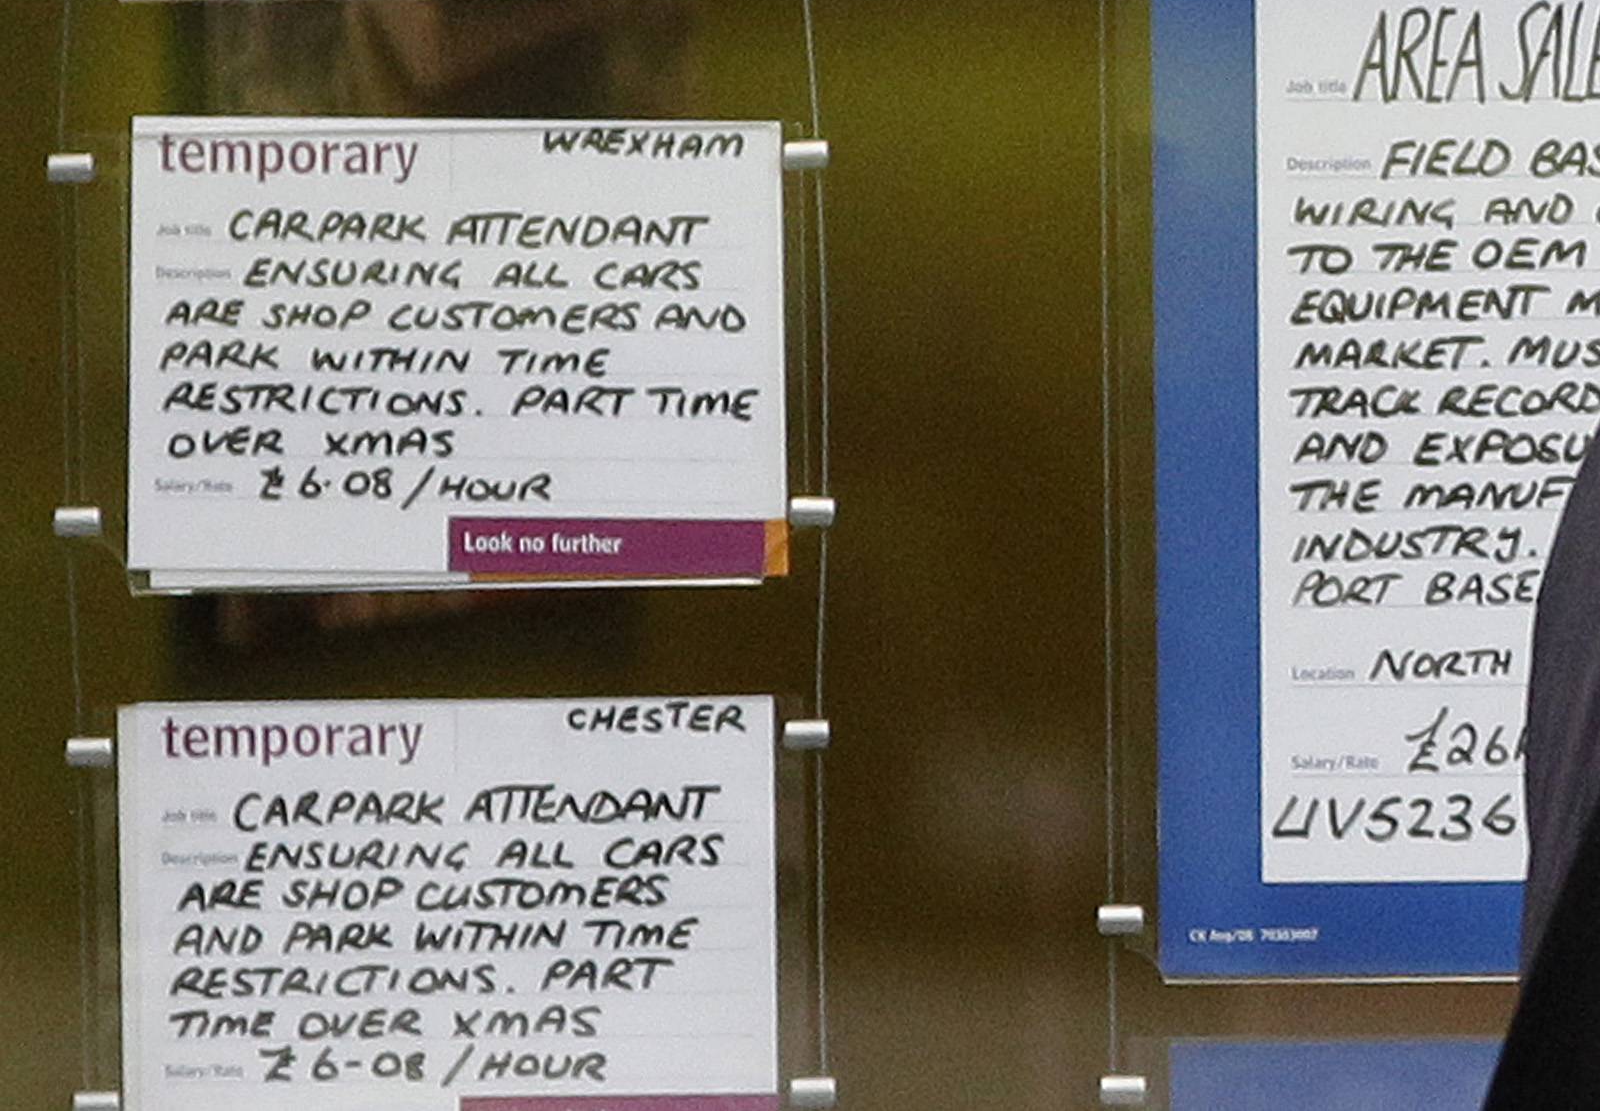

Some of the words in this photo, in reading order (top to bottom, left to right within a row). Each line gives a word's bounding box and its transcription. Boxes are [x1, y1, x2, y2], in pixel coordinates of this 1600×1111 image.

[1353, 7, 1485, 104] AREA
[1286, 80, 1313, 93] Job
[1319, 80, 1346, 94] title
[158, 131, 418, 183] temporary
[543, 127, 743, 158] WREXHAM
[1381, 139, 1511, 180] FIELD
[1287, 157, 1371, 172] Description
[1295, 197, 1455, 230] WIRING
[1485, 193, 1573, 225] AND
[446, 212, 710, 249] ATTENDANT
[1287, 244, 1353, 275] TO
[1372, 239, 1458, 272] THE
[1472, 238, 1586, 270] OEM
[1290, 284, 1550, 325] EQUIPMENT
[160, 340, 278, 371] PARK
[312, 348, 469, 373] WITHIN
[1294, 336, 1489, 370] MARKET.
[1290, 385, 1420, 418] TRACK
[169, 426, 283, 459] OVER
[326, 427, 454, 458] XMAS
[1294, 431, 1388, 465] AND
[1290, 479, 1381, 513] THE
[465, 532, 512, 551] Look
[520, 538, 544, 552] no
[553, 533, 621, 553] further
[1294, 570, 1402, 607] PORT
[1292, 667, 1355, 680] Location
[1370, 649, 1512, 680] NORTH
[568, 701, 745, 733] CHESTER
[162, 717, 422, 766] temporary
[1292, 755, 1378, 771] Salary/Rate
[465, 784, 721, 824] ATTENDANT
[245, 839, 469, 873] ENSURING
[496, 839, 574, 869] ALL
[604, 834, 724, 870] CARS
